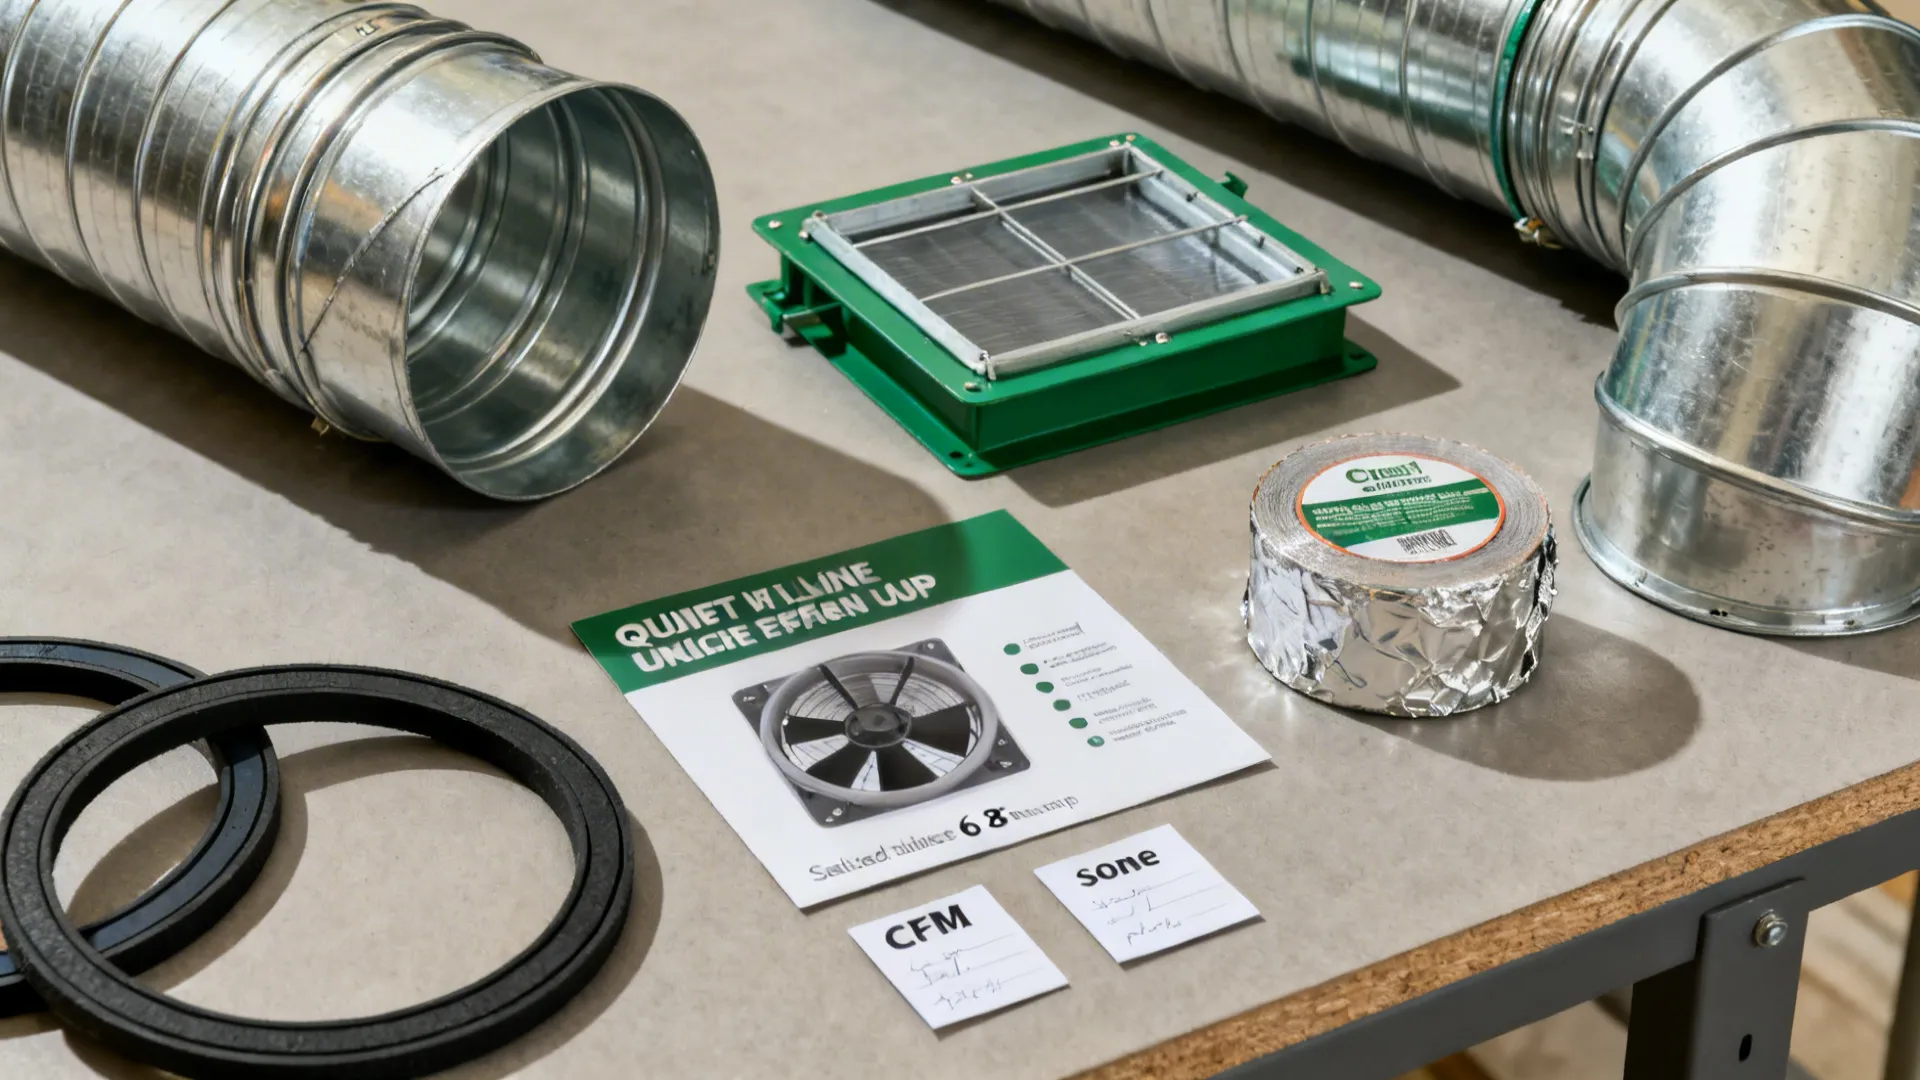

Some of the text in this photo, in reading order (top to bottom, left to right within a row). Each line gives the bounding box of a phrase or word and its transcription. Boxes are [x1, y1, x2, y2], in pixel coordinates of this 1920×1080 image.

[959, 815, 982, 837] 6
[1076, 849, 1160, 887] sone
[885, 904, 973, 950] CFM
